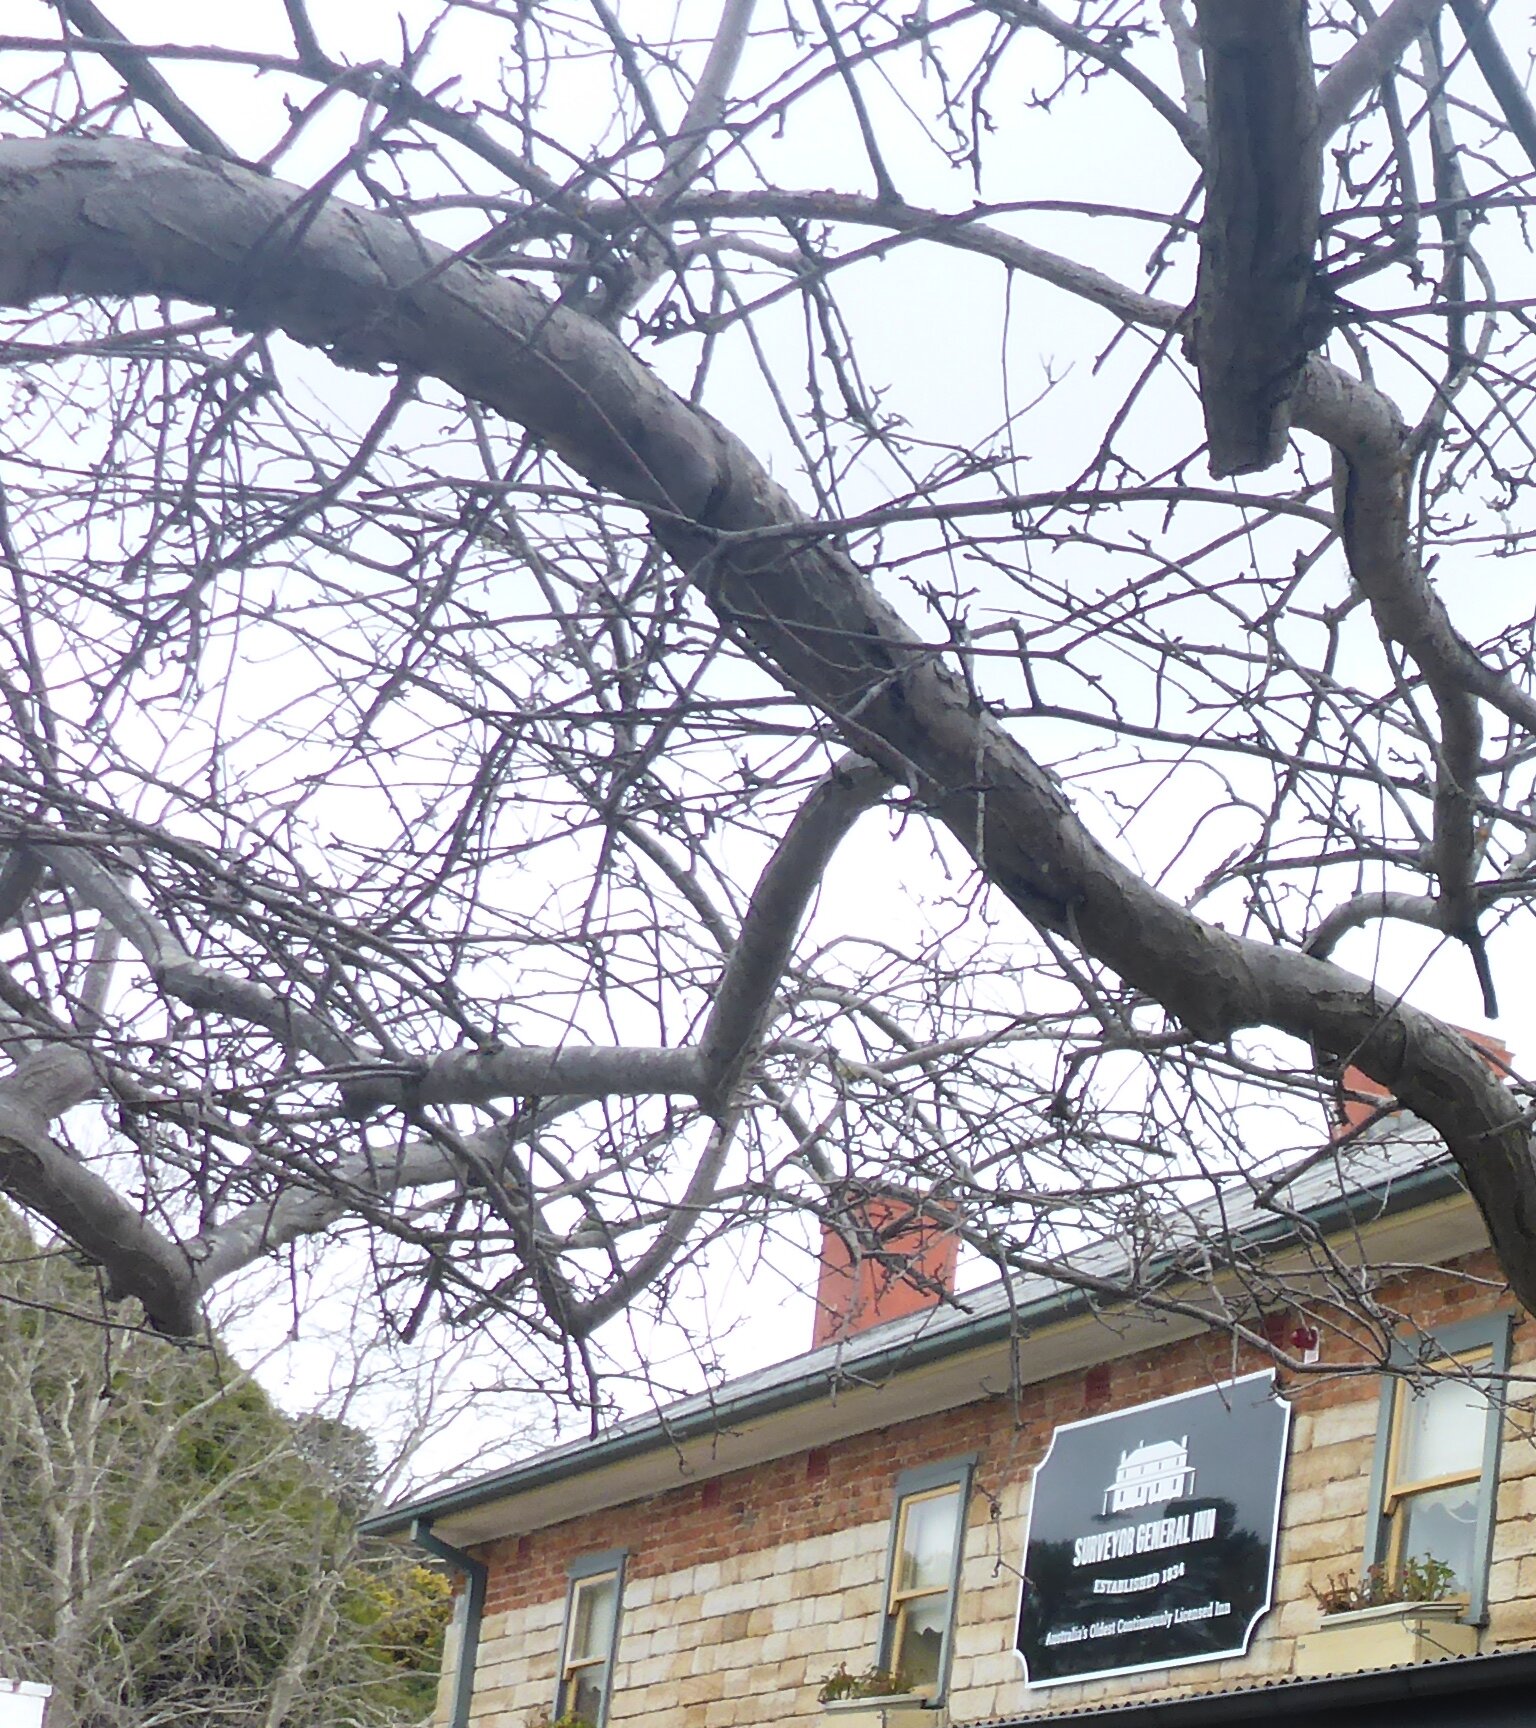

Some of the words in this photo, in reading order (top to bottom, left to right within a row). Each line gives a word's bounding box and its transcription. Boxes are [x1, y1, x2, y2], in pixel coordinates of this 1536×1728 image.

[1073, 1526, 1135, 1567] SURVEYOR
[1135, 1514, 1190, 1554] GENERAL
[1192, 1508, 1217, 1542] INN
[1093, 1572, 1160, 1594] ESTABLISHED
[1162, 1562, 1186, 1583] 1834
[1045, 1626, 1087, 1646] Australia's
[1089, 1621, 1116, 1639] Oldest
[1215, 1601, 1232, 1616] Inn
